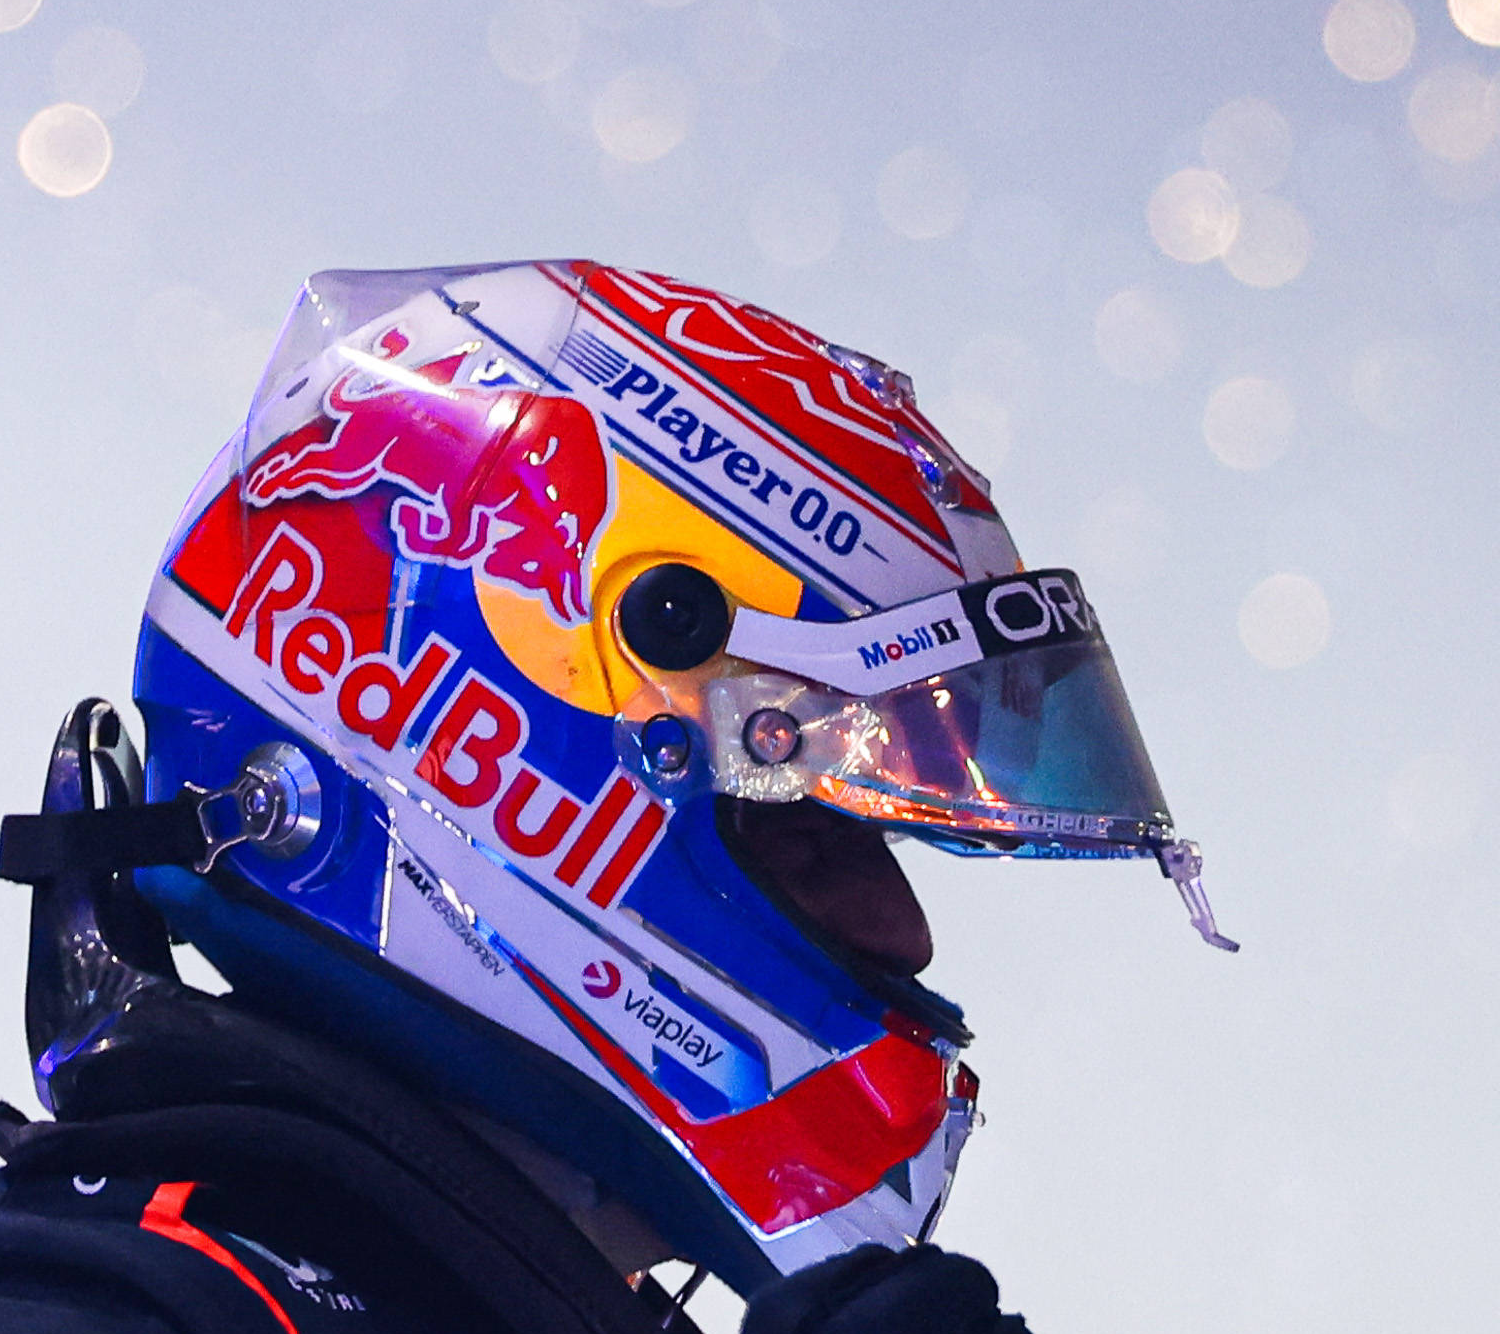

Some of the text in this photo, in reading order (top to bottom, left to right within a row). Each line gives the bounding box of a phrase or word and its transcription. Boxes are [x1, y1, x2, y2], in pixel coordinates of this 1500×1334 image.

[603, 364, 861, 555] Player 0.0
[857, 627, 934, 669] Mobil
[985, 577, 1098, 642] OR
[225, 531, 667, 910] Red Bull
[623, 988, 724, 1067] viaplay
